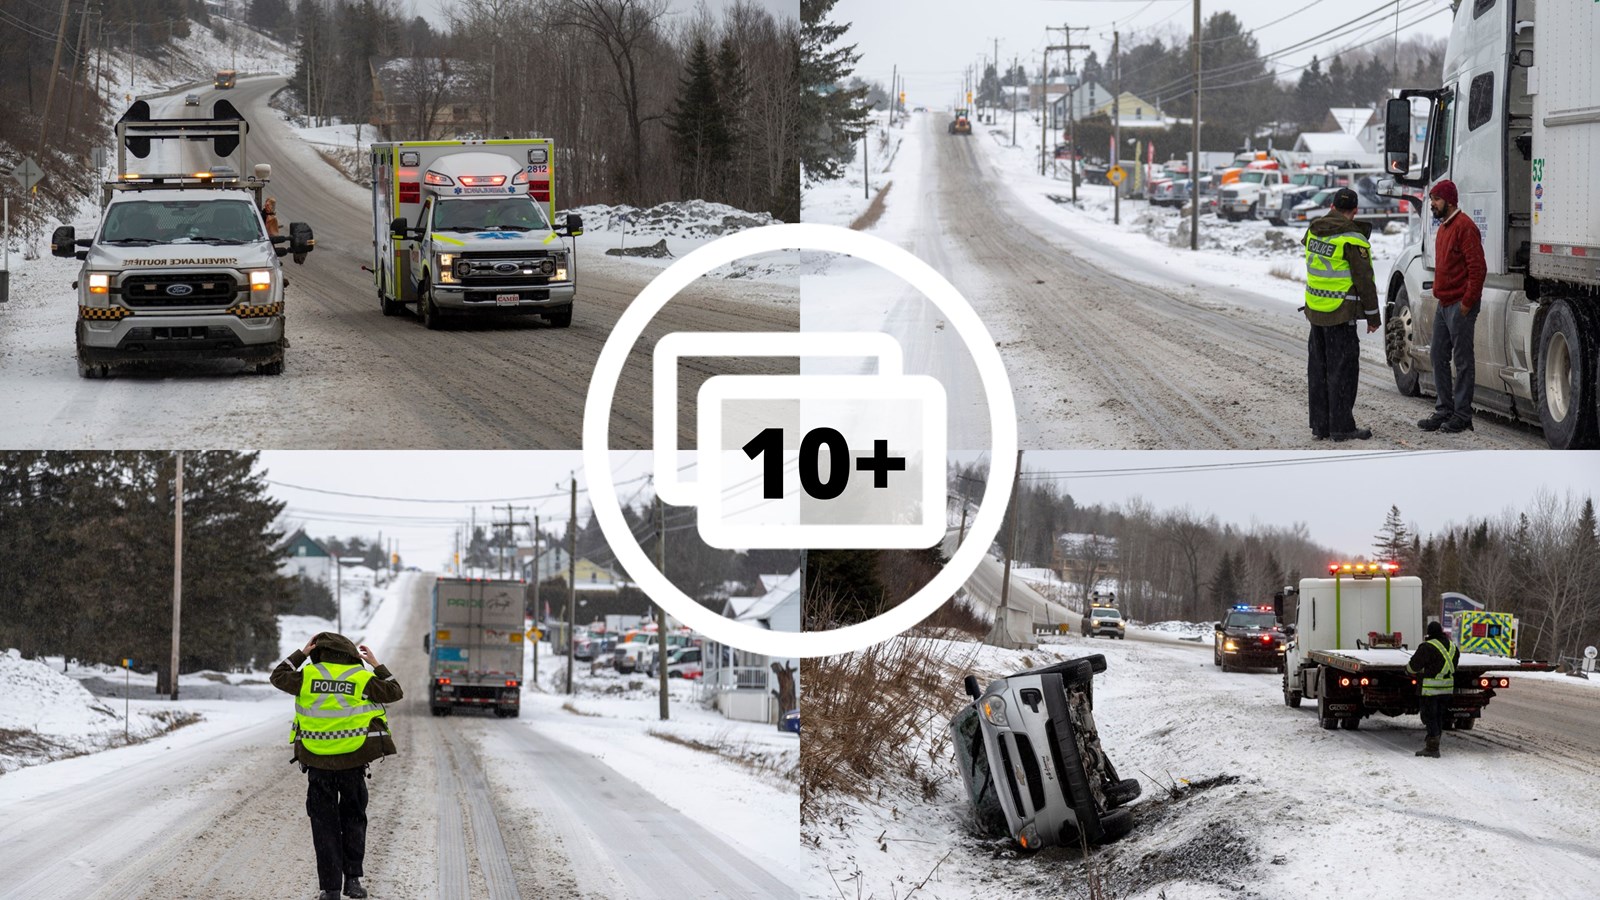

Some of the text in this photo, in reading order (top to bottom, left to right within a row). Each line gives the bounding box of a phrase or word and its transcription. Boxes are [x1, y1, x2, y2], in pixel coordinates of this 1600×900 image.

[527, 165, 547, 173] 2812
[1532, 158, 1545, 182] 53'
[1309, 240, 1334, 256] POLICE
[313, 681, 353, 694] POLICE
